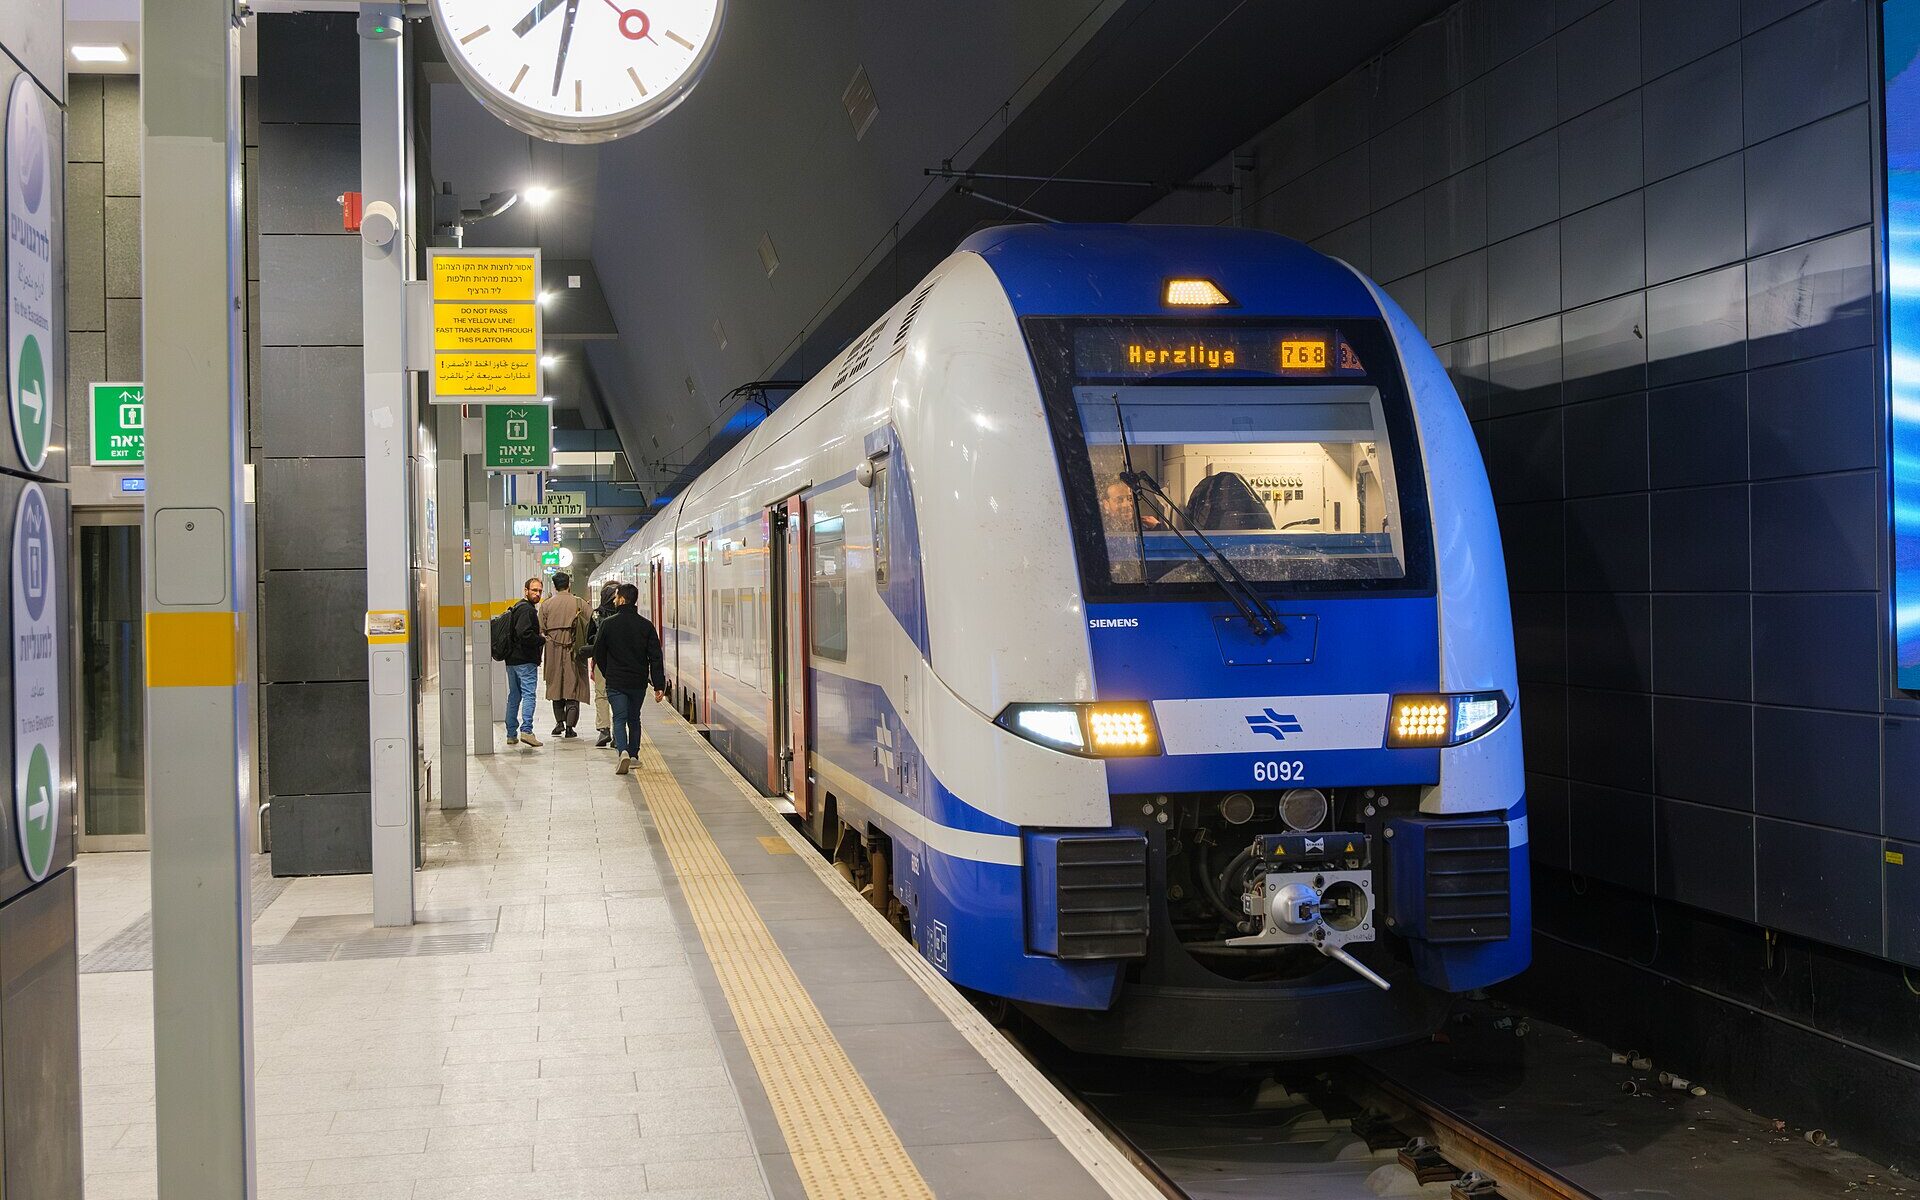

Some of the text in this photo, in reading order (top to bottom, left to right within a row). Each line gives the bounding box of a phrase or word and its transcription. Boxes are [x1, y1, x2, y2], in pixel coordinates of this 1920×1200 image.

[462, 264, 475, 272] הקו
[490, 263, 513, 271] לחצות
[446, 275, 471, 283] חולפות
[1129, 345, 1235, 367] Herzliya
[1284, 346, 1324, 363] 768
[499, 446, 535, 456] יציאה
[530, 504, 582, 515] למרחב מוגן
[1089, 618, 1139, 628] SIEMENS
[1253, 760, 1305, 782] 6092
